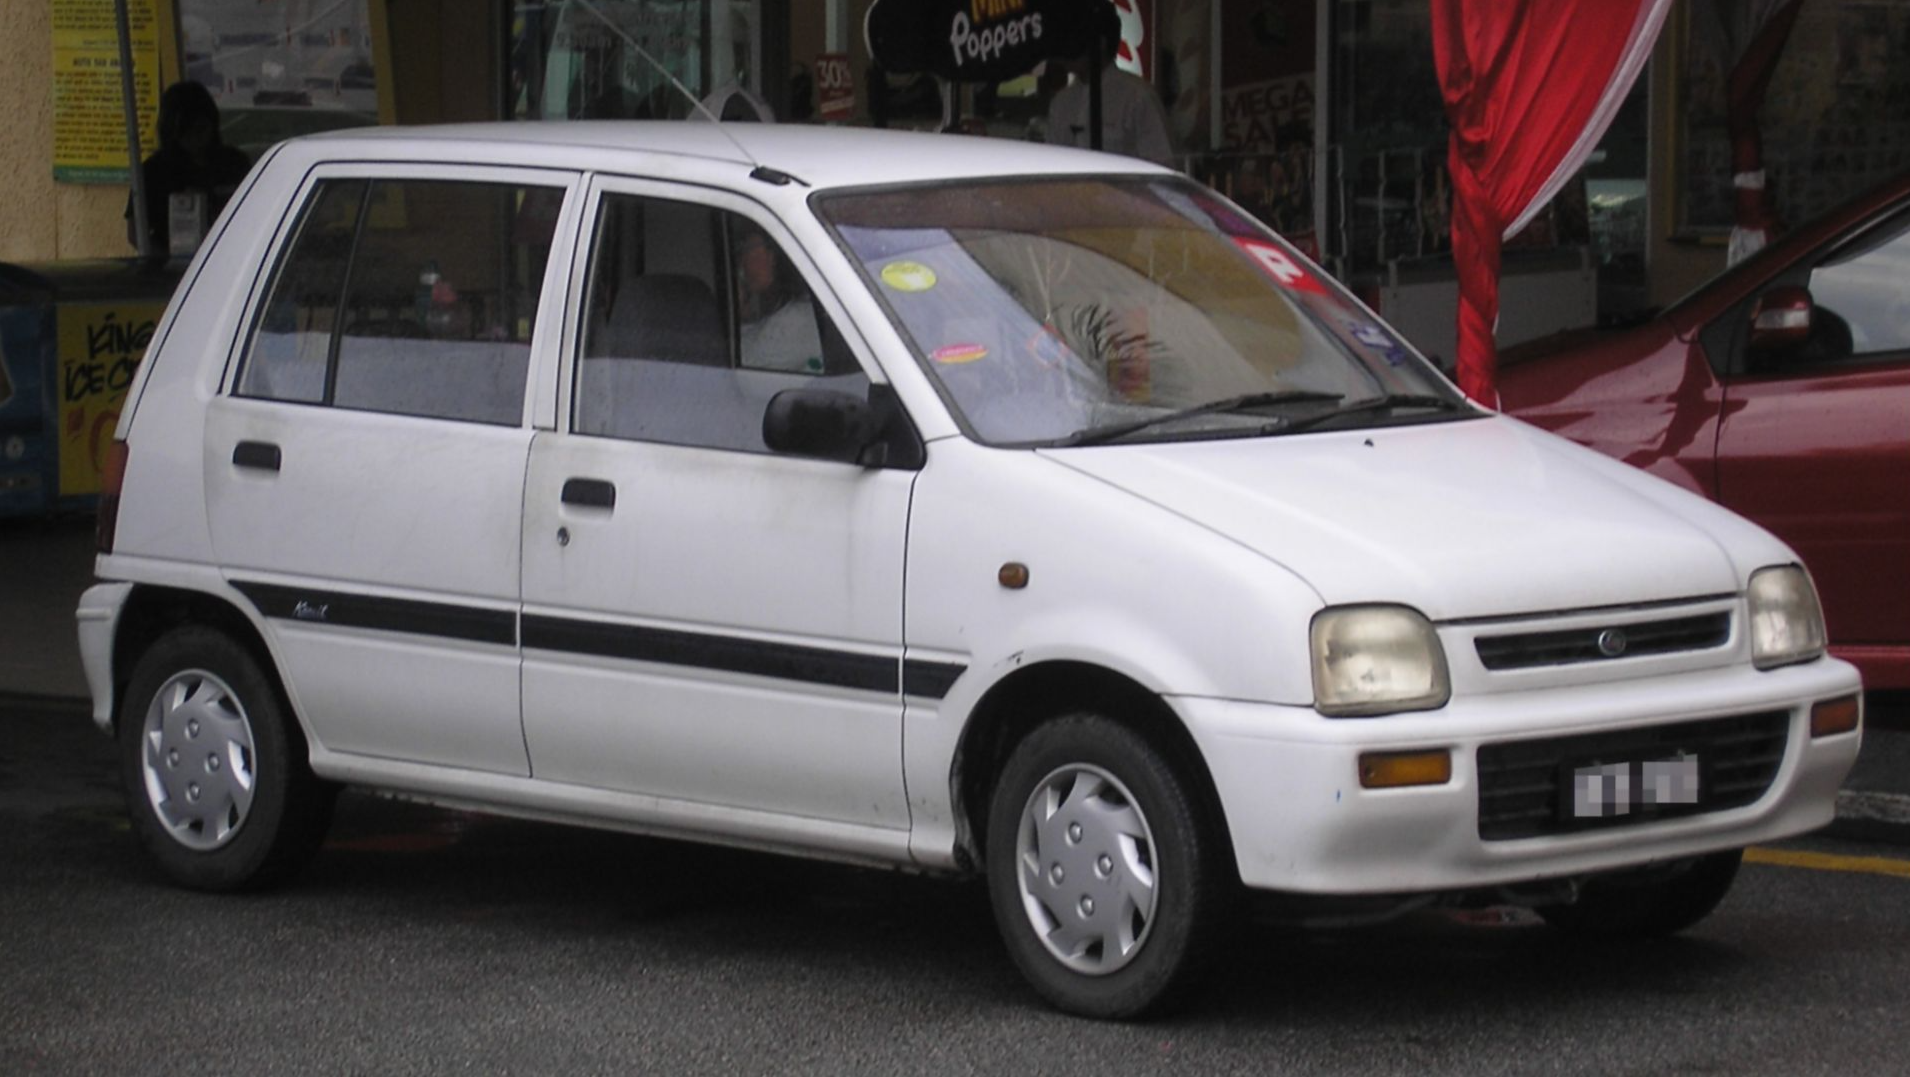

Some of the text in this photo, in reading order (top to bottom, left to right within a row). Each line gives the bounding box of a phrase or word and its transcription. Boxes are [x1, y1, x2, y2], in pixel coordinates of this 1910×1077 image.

[950, 11, 1042, 67] Poppers
[1221, 79, 1314, 121] MEGA
[1223, 112, 1294, 157] SAL
